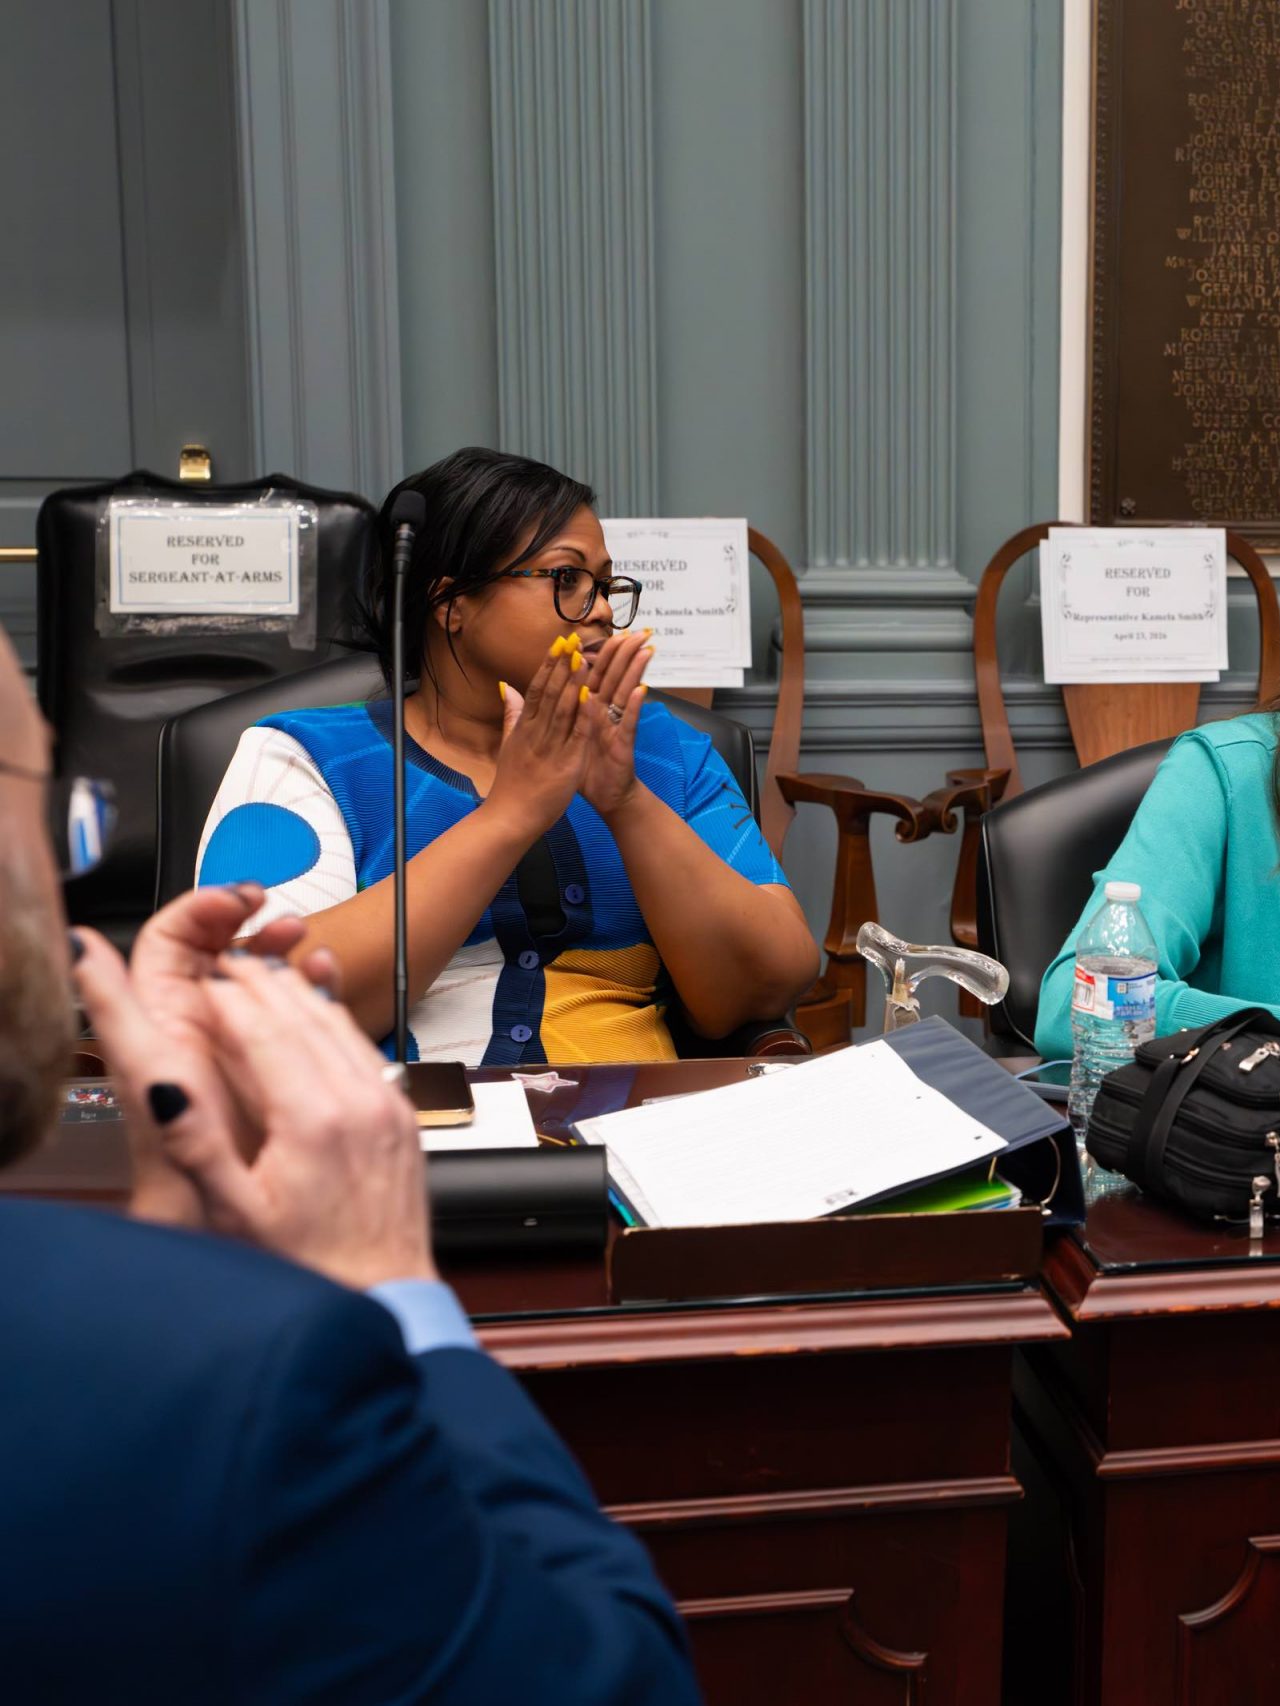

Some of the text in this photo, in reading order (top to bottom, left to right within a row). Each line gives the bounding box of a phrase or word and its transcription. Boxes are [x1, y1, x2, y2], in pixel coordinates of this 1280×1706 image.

[1211, 243, 1262, 258] JAMES
[1199, 311, 1246, 327] KENT
[166, 535, 245, 548] RESERVED
[191, 553, 220, 565] FOR
[613, 559, 688, 572] RESERVED
[128, 570, 283, 584] SERGEANT-AT-ARMS
[1105, 566, 1171, 579] RESERVED
[1126, 586, 1151, 598] FOR
[655, 608, 693, 616] Kamela
[696, 607, 725, 616] Smith
[1073, 612, 1204, 624] Representative Kamela Smith
